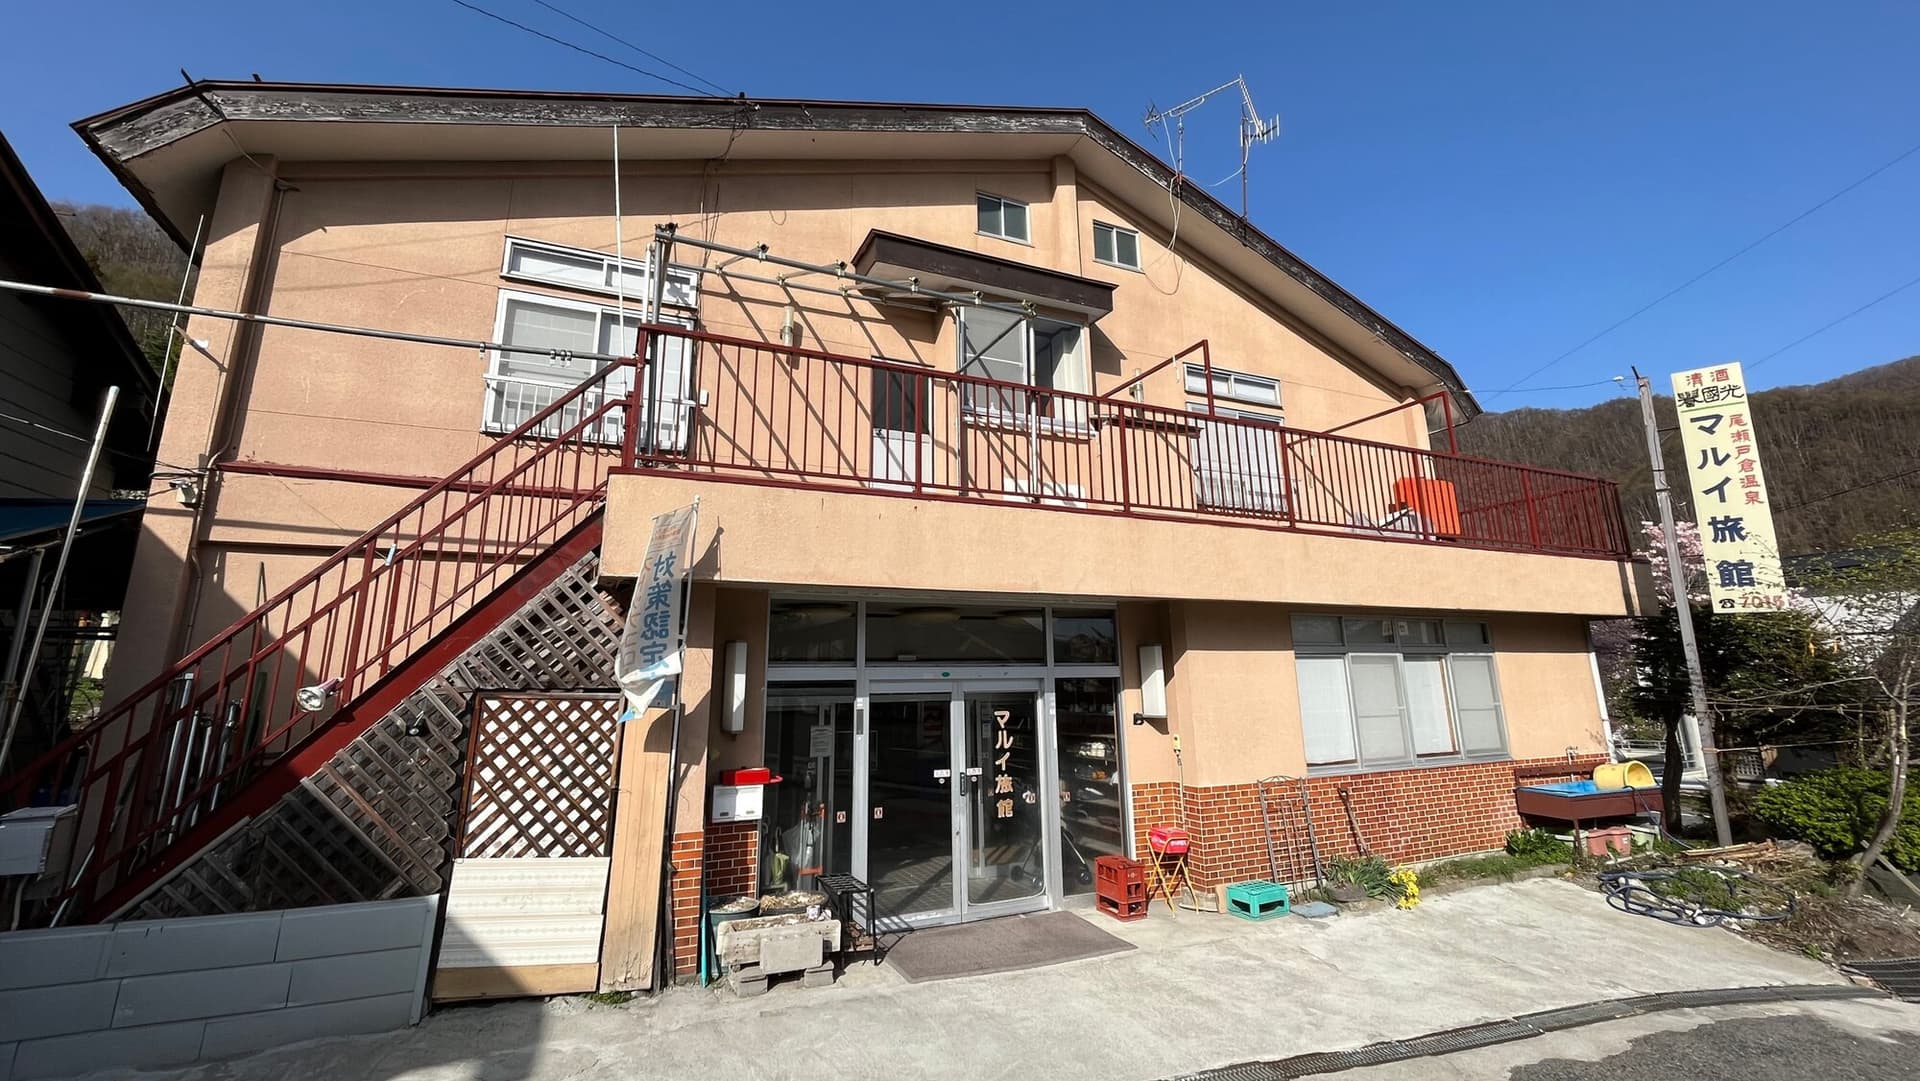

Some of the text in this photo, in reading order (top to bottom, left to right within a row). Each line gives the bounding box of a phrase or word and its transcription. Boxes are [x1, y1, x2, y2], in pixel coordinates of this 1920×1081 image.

[1685, 368, 1729, 387] 清酒
[1690, 413, 1756, 588] マルイ旅館
[1728, 413, 1765, 505] 尾瀬戸倉温泉
[994, 710, 1014, 818] マルイ旅館
